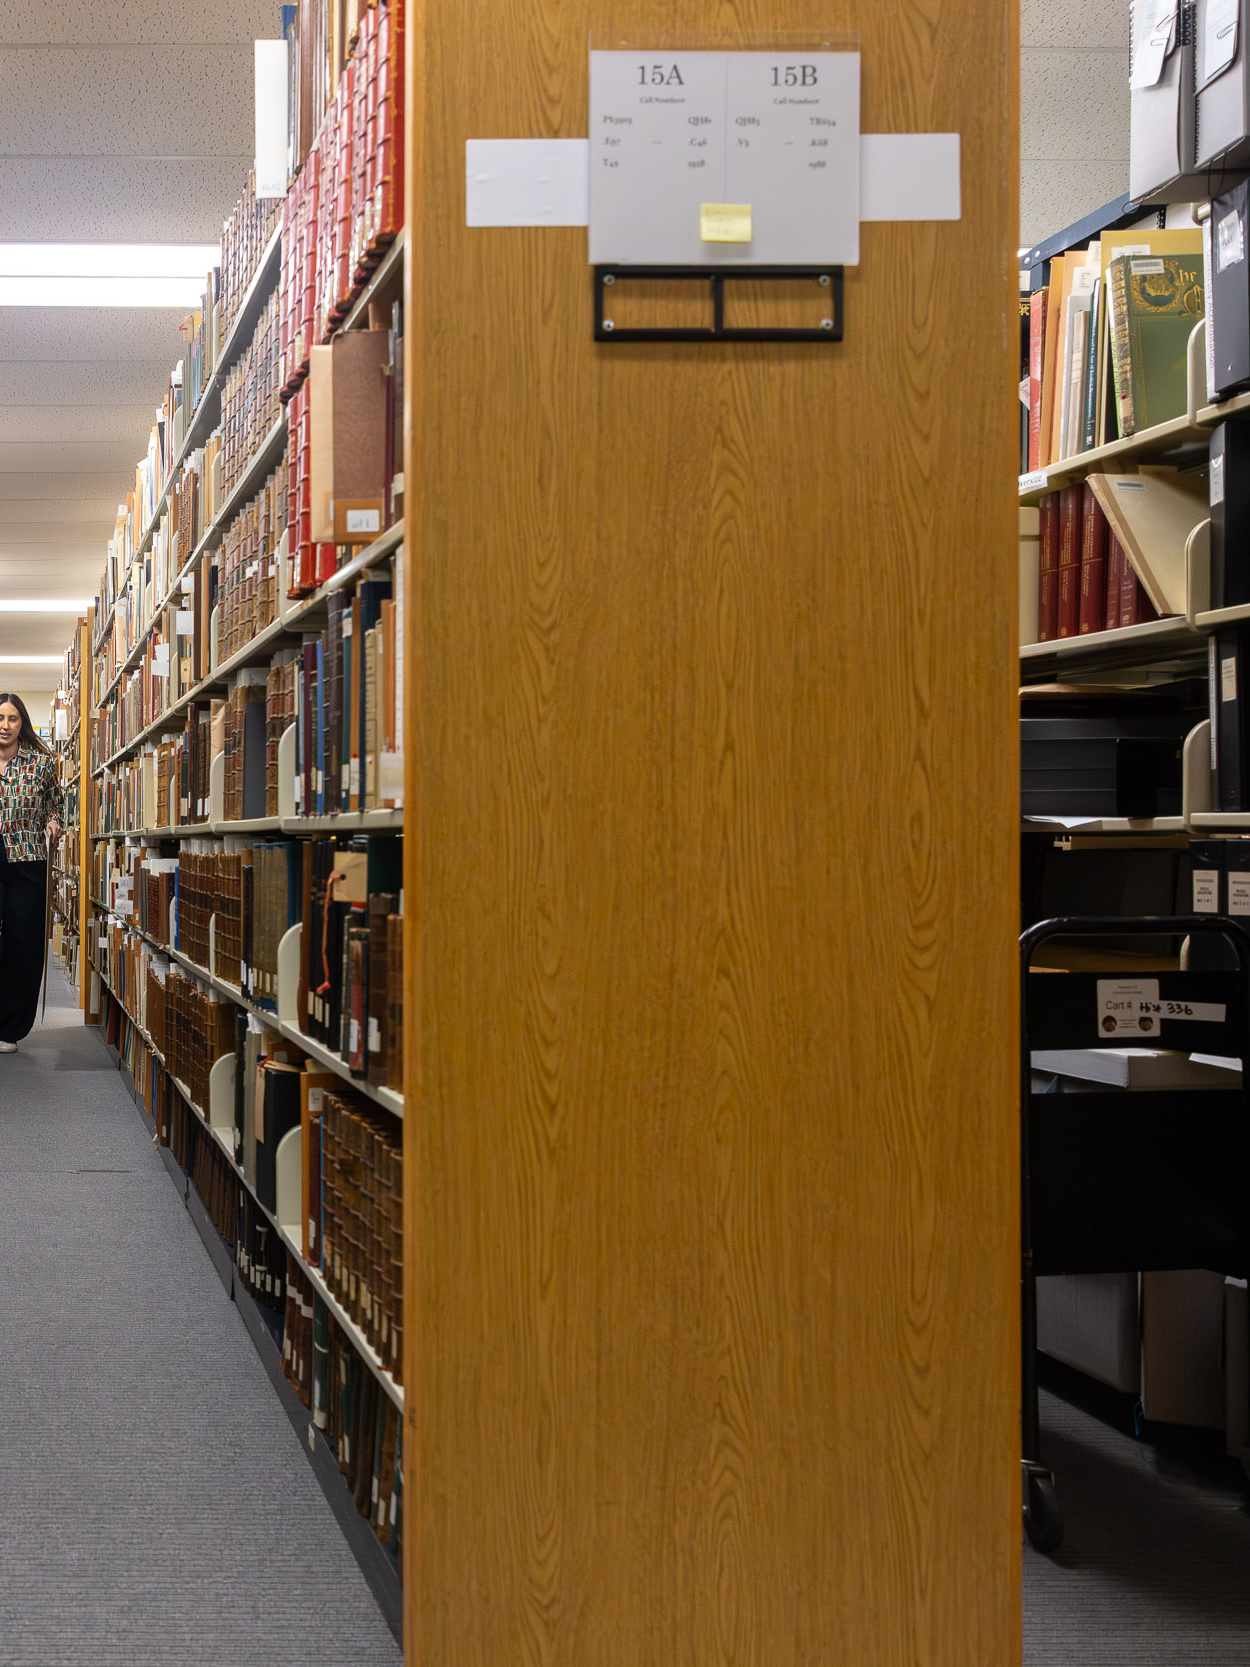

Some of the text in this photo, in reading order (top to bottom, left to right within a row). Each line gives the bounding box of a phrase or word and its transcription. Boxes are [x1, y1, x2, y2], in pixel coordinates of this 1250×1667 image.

[638, 64, 685, 86] 15A
[771, 64, 818, 87] 15B
[1106, 1000, 1126, 1010] Cart
[1166, 1002, 1193, 1015] 336
